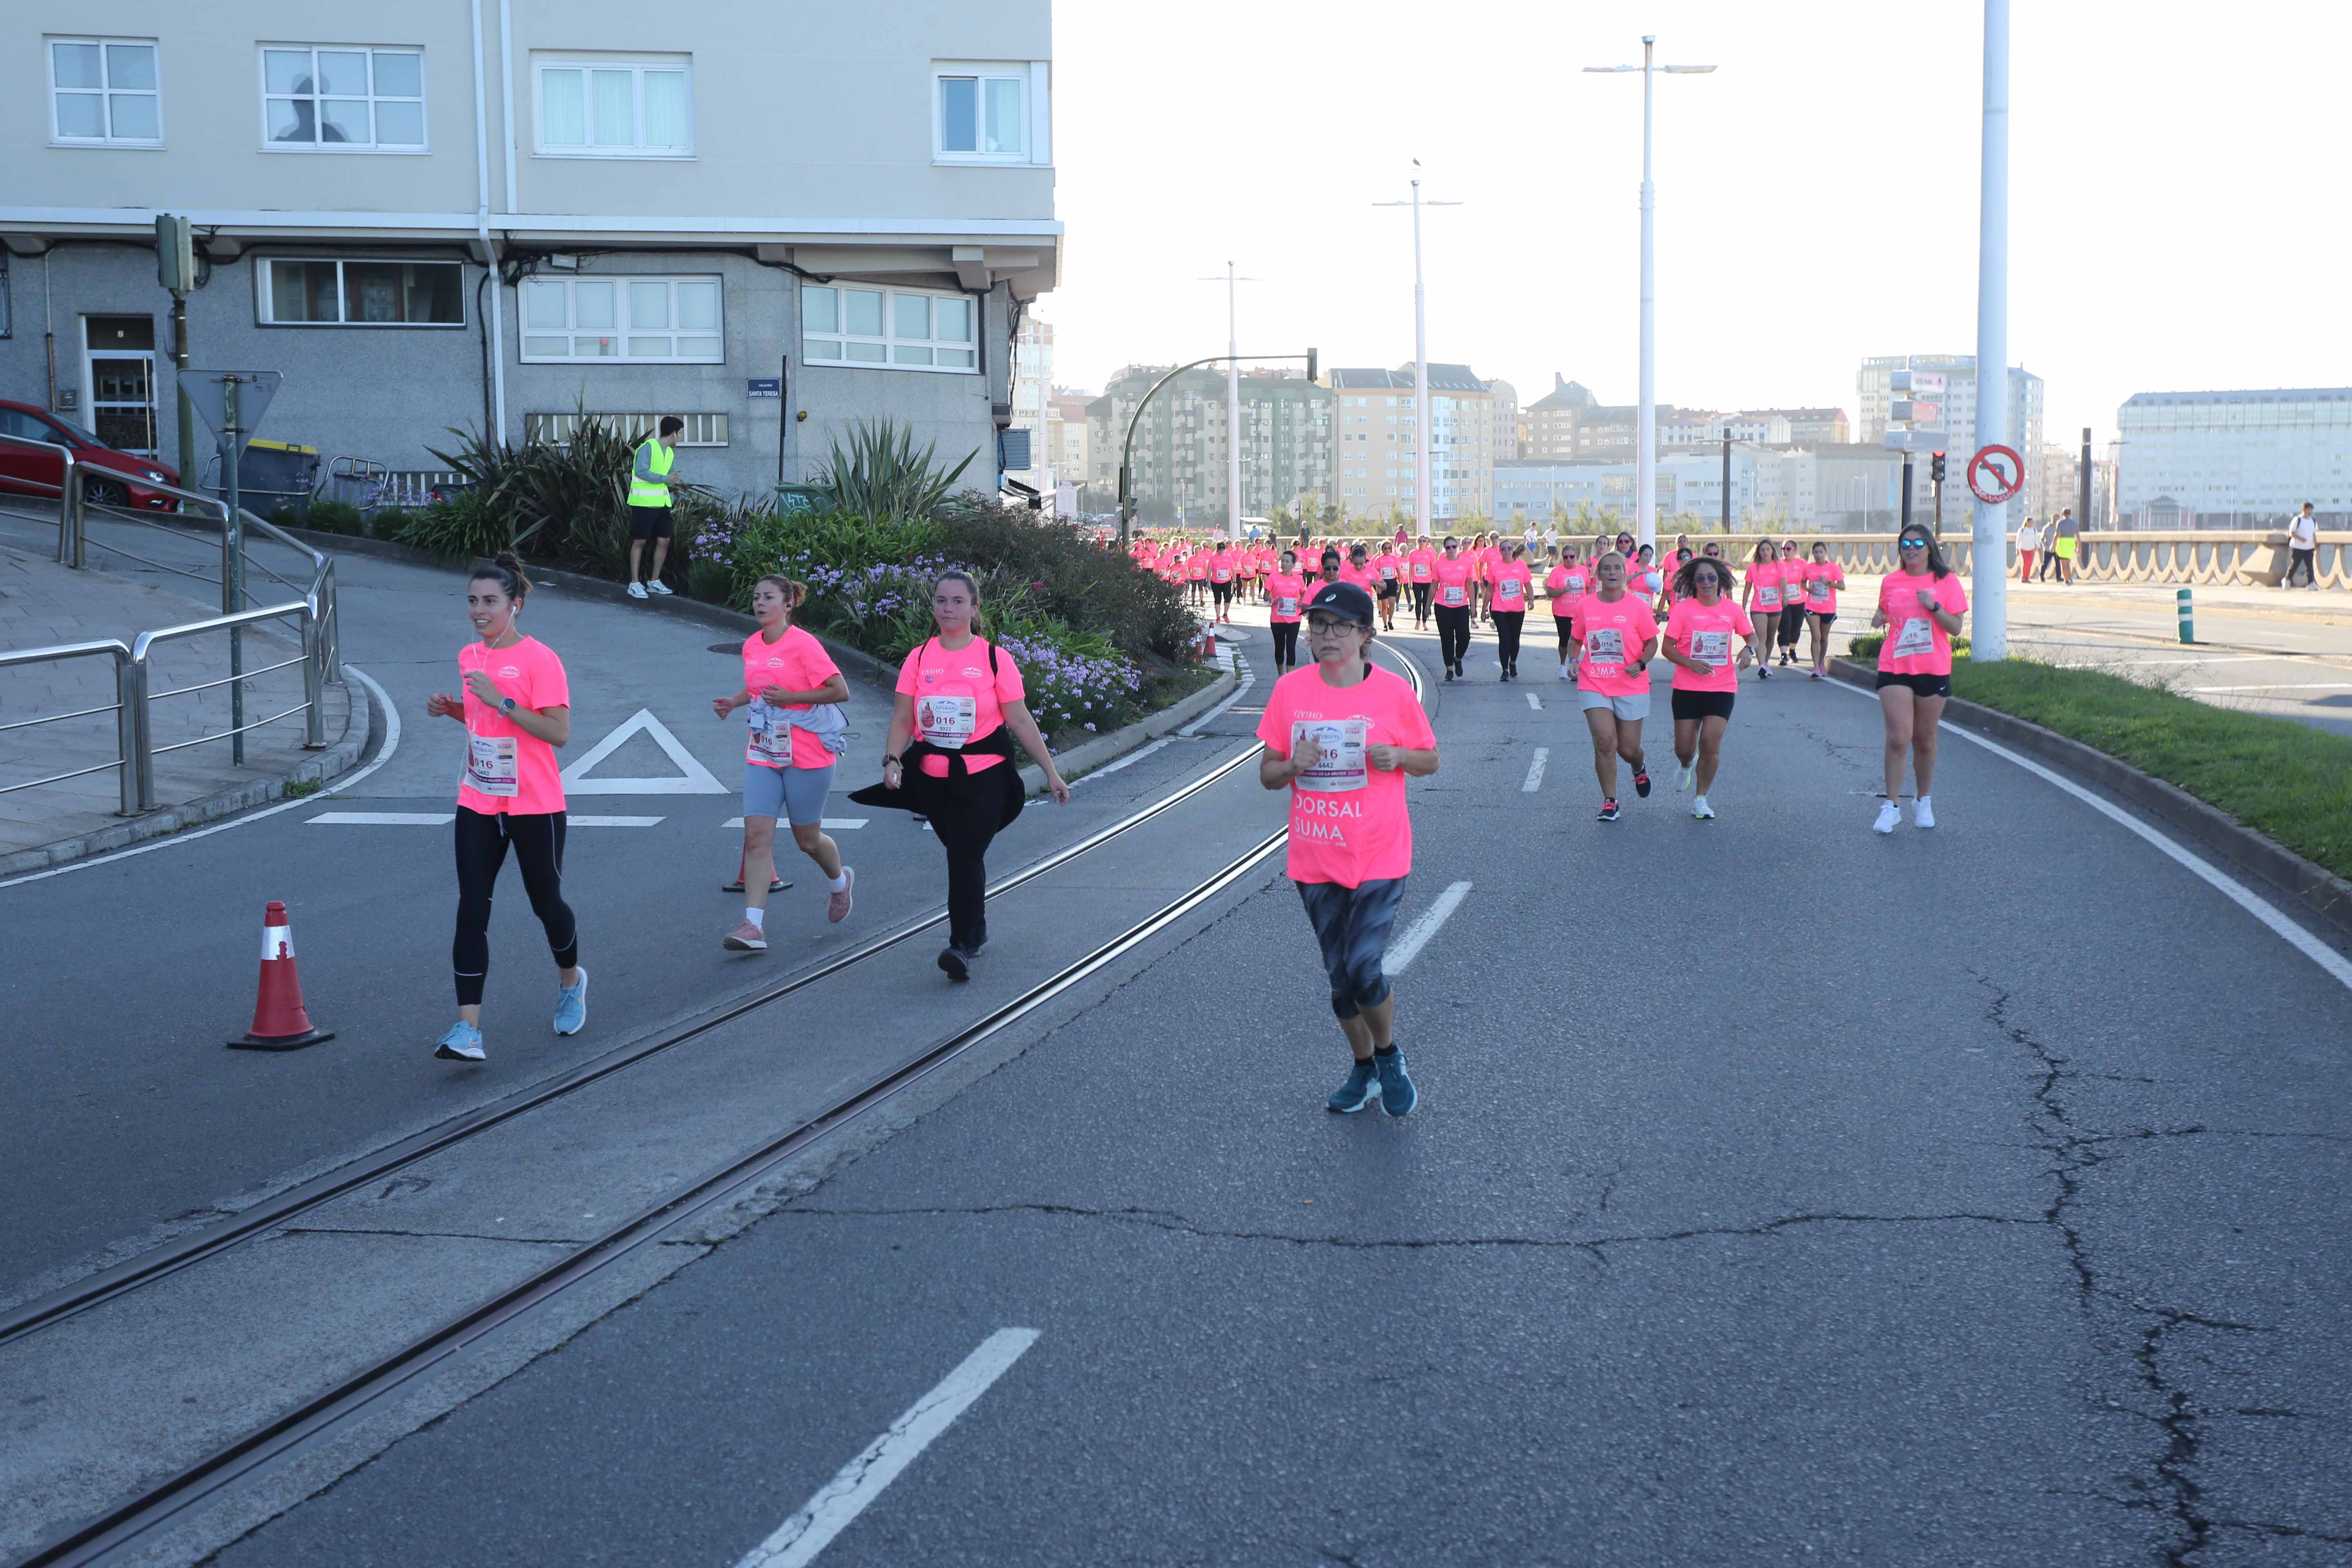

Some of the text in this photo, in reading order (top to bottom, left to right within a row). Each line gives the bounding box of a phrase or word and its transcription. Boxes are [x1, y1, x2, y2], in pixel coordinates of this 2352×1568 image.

[762, 735, 773, 745] 016
[1324, 749, 1338, 759] 16
[475, 757, 493, 768] 016
[1296, 794, 1362, 817] DORSAL
[1295, 816, 1343, 840] SUMA
